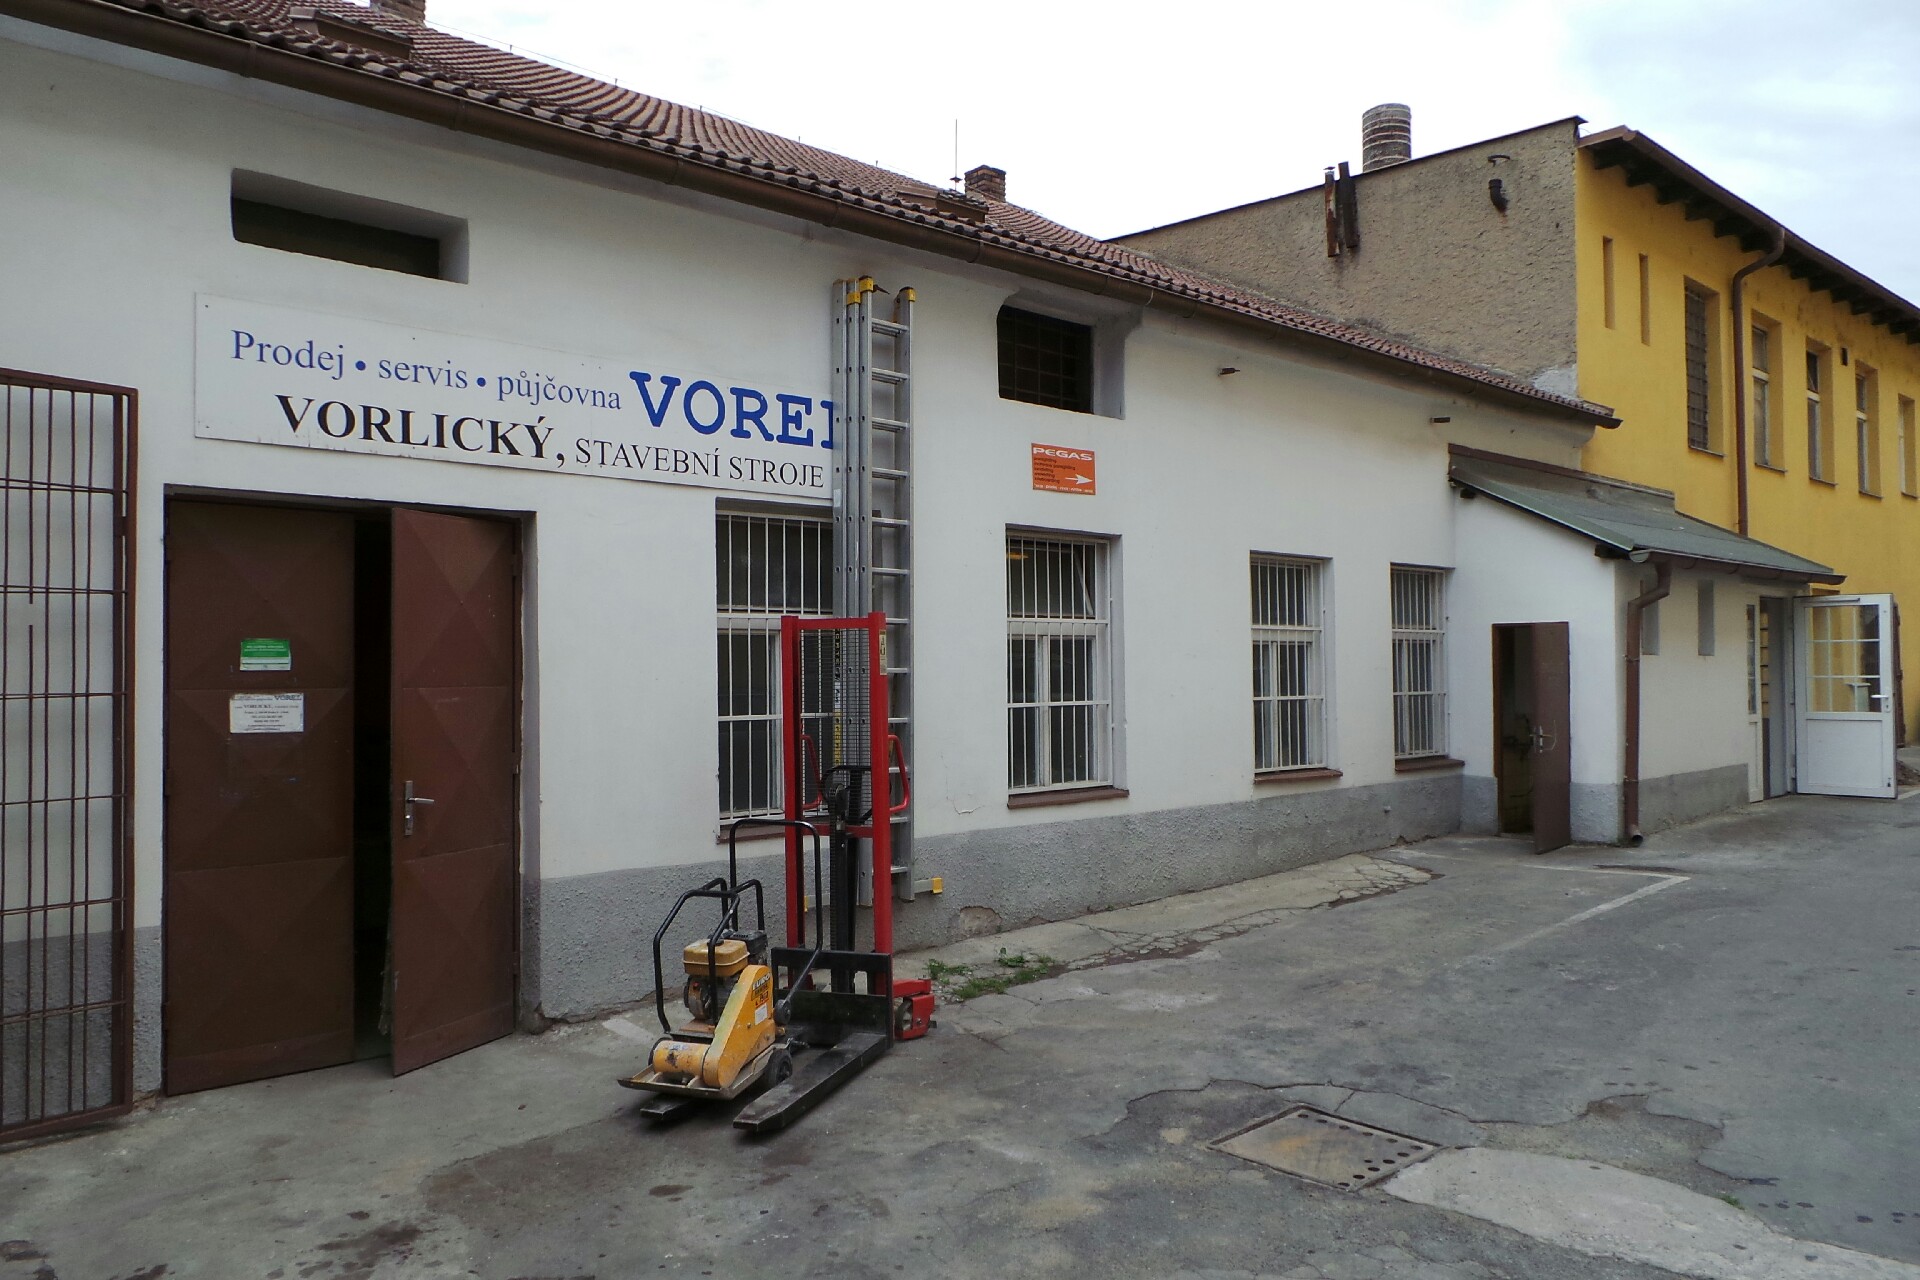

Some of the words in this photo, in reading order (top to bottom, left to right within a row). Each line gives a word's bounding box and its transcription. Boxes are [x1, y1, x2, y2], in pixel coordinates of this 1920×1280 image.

[231, 330, 344, 380] Prodej
[378, 359, 468, 389] servis
[497, 370, 621, 410] půjčovna
[274, 394, 566, 468] VORLICKÝ,
[575, 438, 720, 477] STAVEBNÍ
[729, 456, 825, 488] STROJE
[1033, 447, 1093, 461] PEGAS
